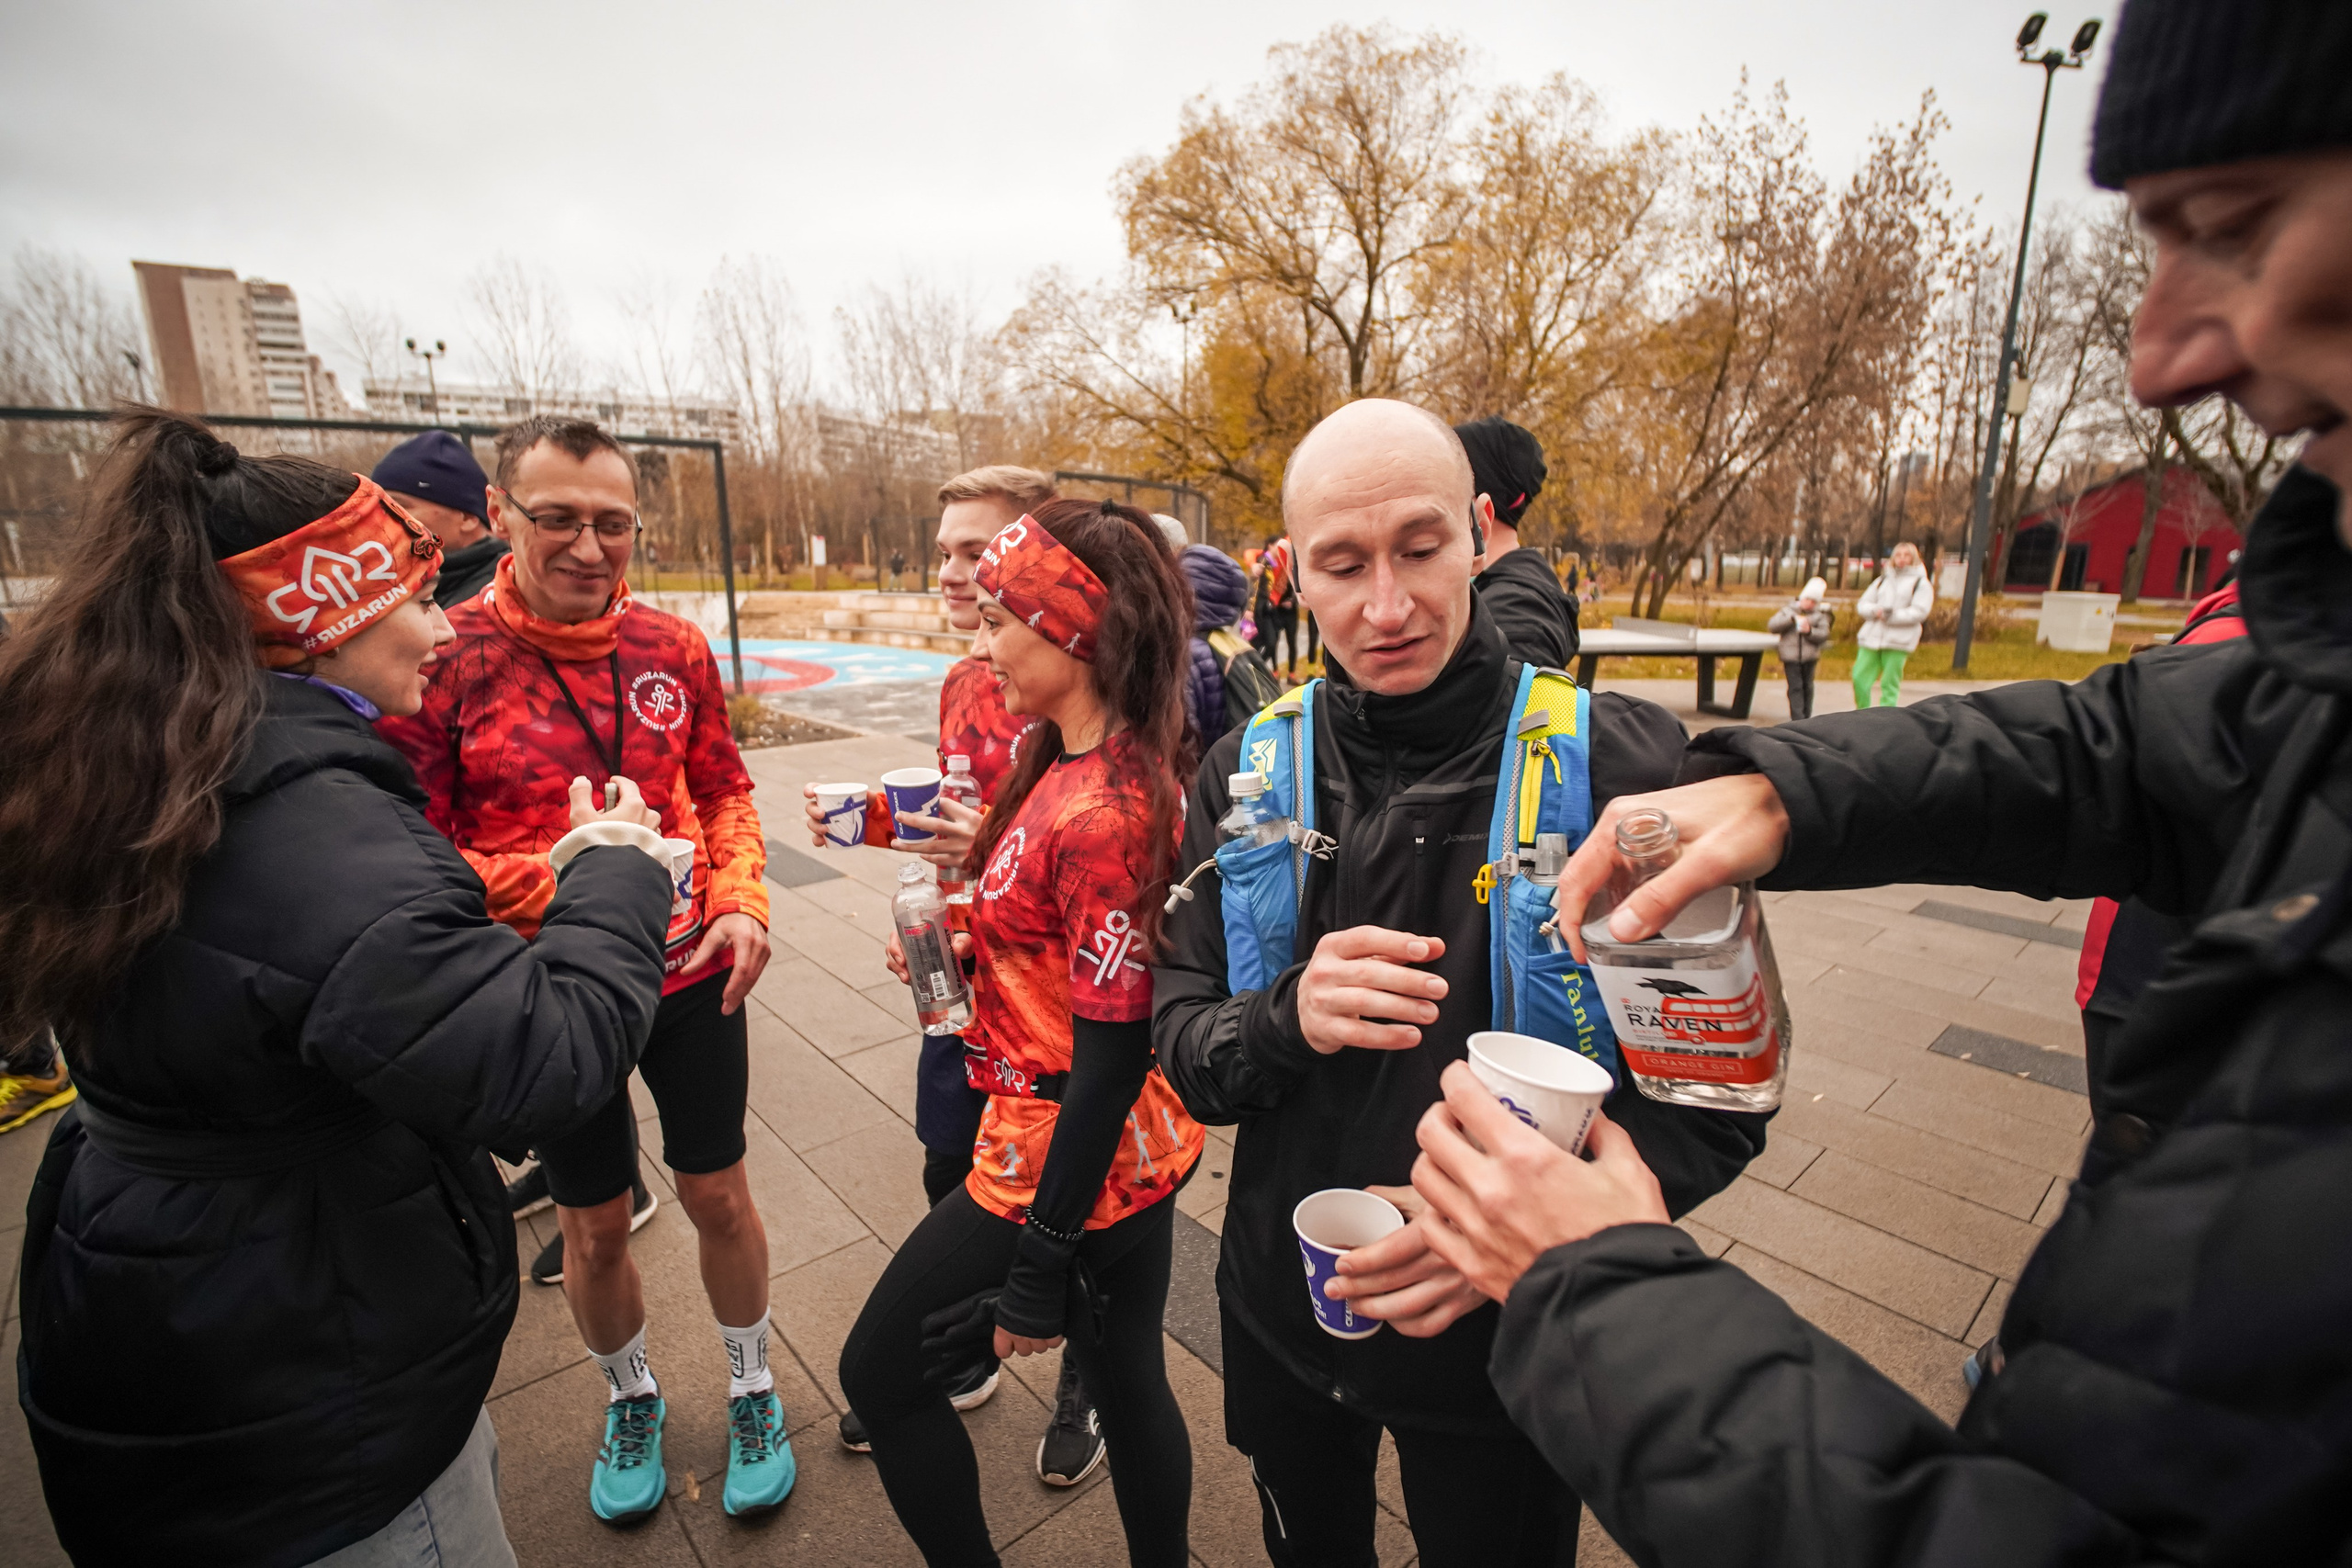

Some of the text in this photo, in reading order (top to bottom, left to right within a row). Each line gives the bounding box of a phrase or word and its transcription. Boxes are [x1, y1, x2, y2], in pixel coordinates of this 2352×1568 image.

[1627, 1013, 1724, 1032] RAVEN
[1650, 1057, 1736, 1072] ORANGE GIN
